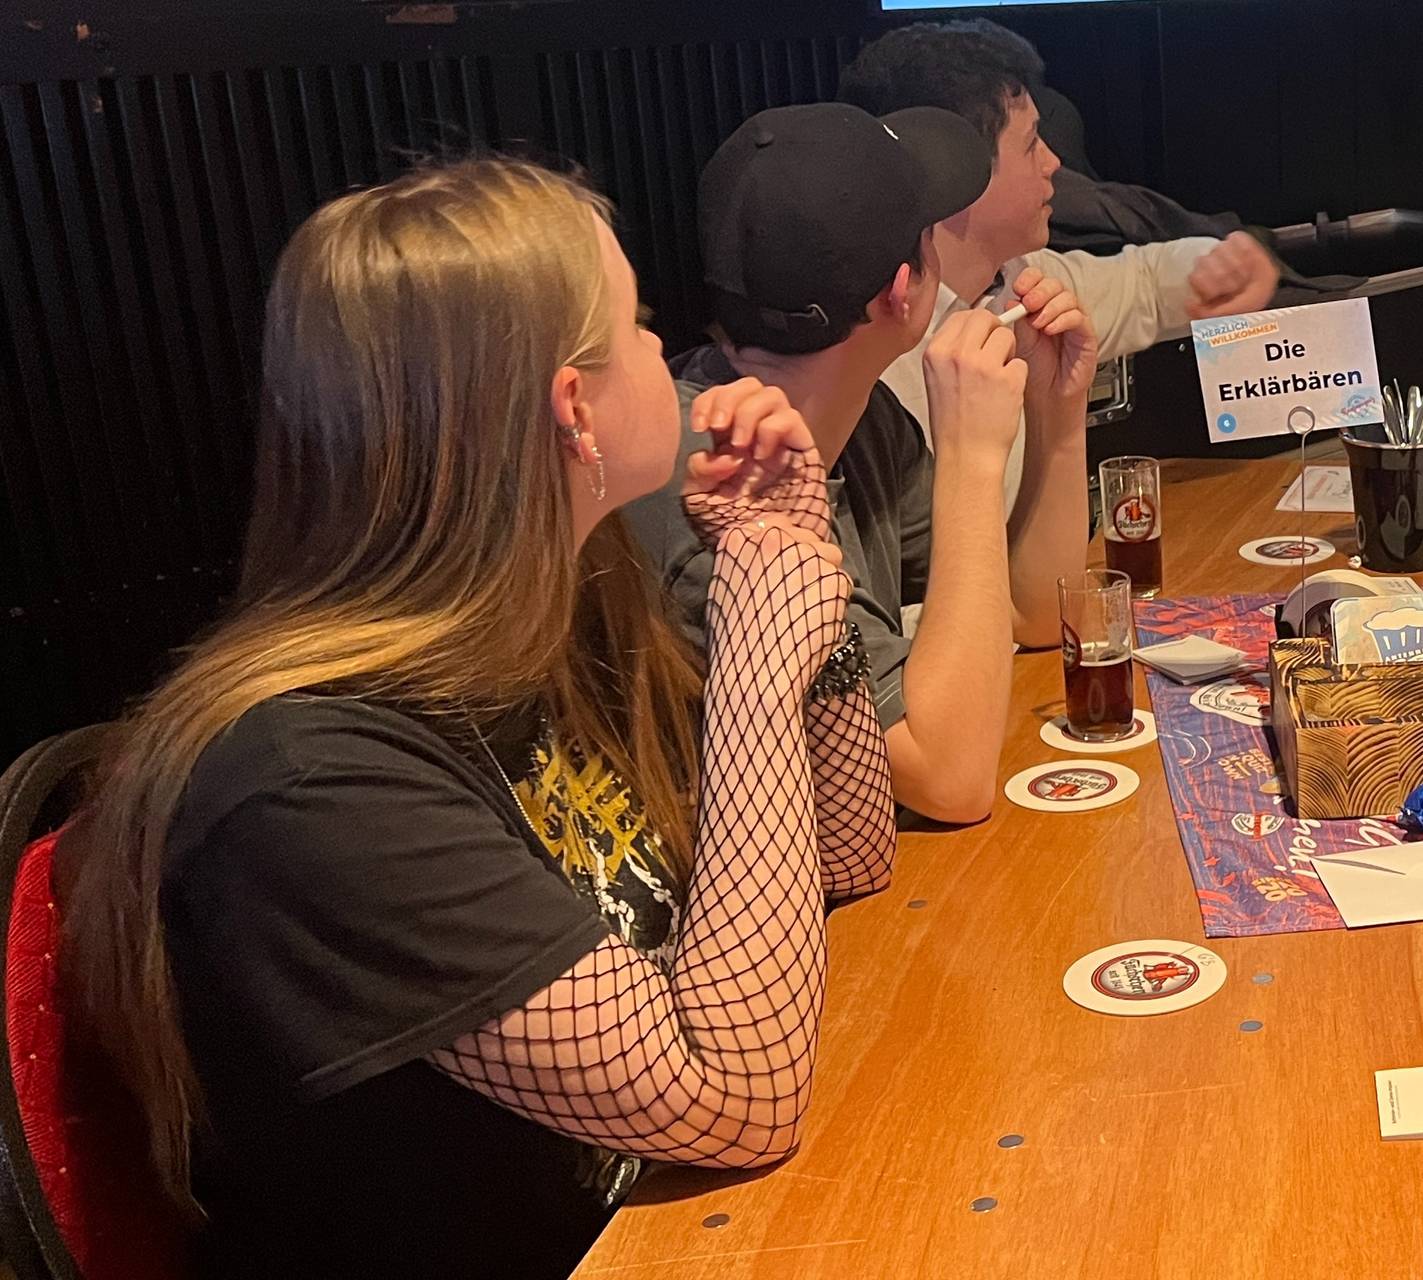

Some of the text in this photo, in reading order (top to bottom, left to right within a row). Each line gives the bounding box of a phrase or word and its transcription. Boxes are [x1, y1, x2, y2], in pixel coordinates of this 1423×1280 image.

[1202, 321, 1249, 339] HERZLICH
[1211, 324, 1278, 346] WILLKOMMEN
[1264, 339, 1306, 361] Die
[1218, 370, 1362, 402] Erklärbären
